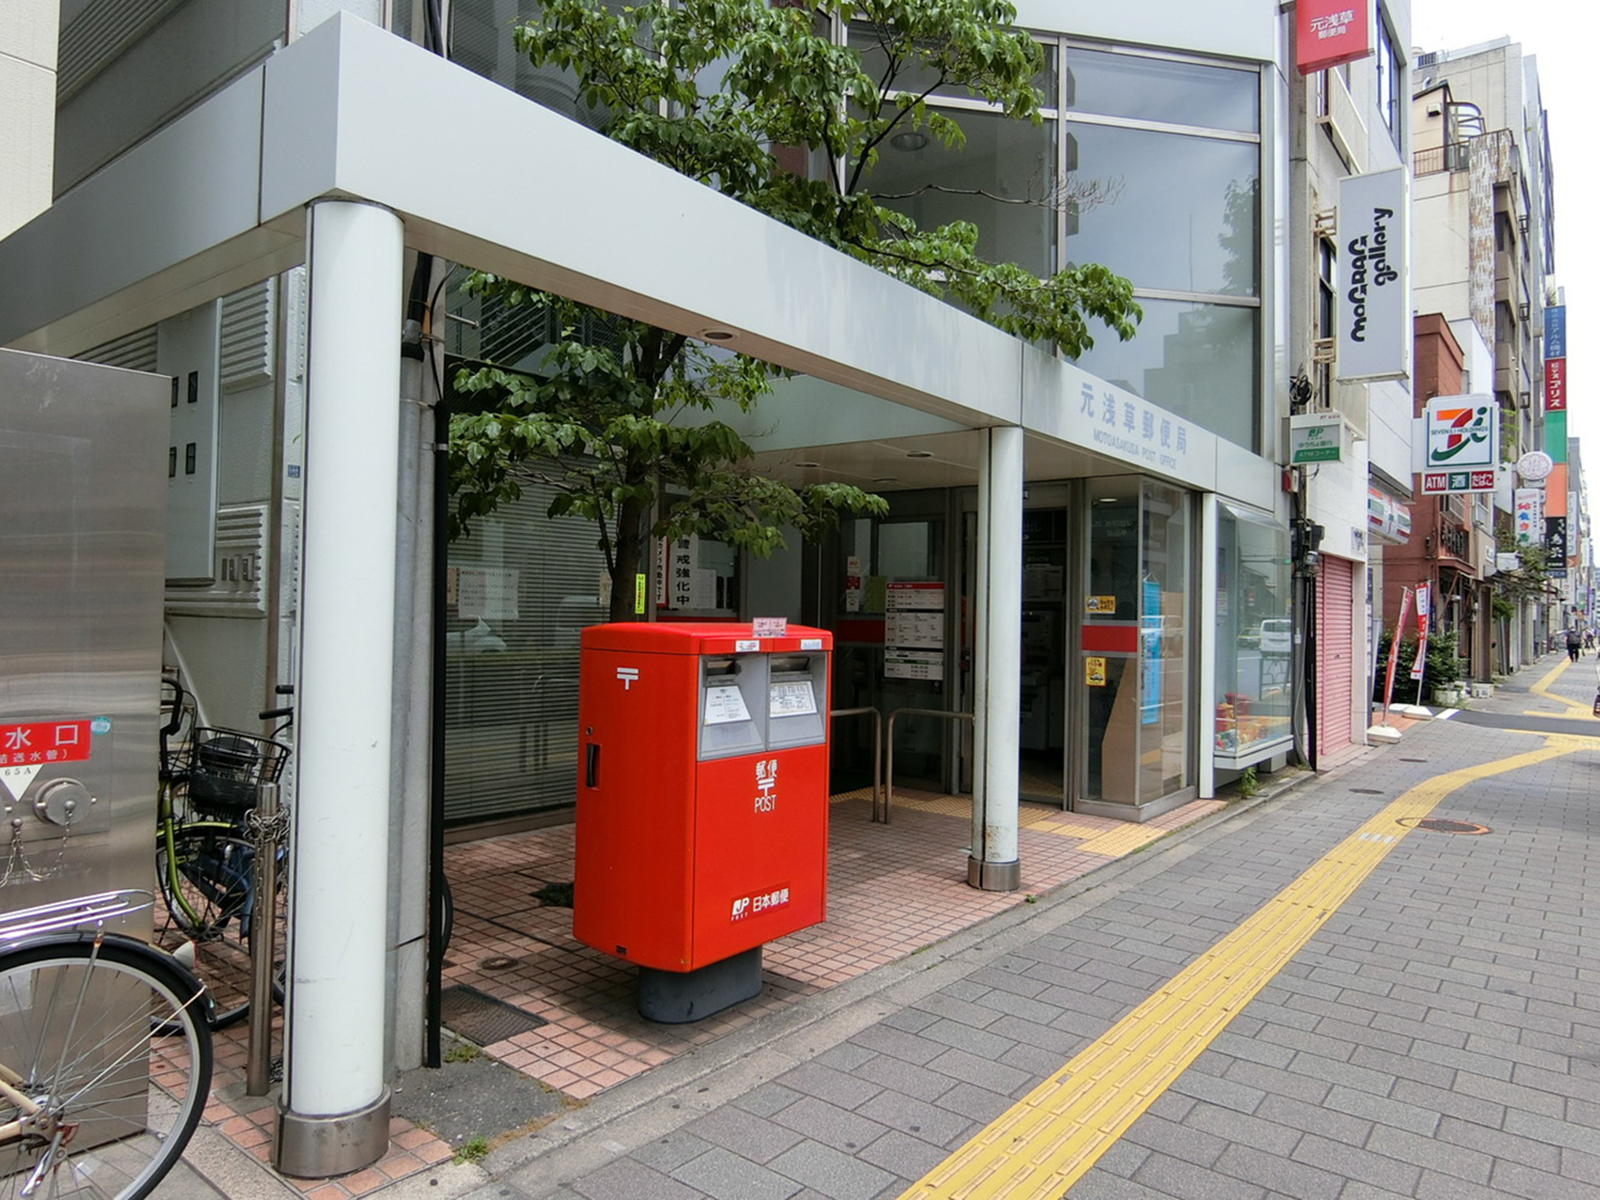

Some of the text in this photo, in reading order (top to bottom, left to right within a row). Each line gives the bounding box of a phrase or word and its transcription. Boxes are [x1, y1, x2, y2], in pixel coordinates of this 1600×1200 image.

[1309, 9, 1354, 32] 元浅草
[1317, 24, 1346, 40] 郵便局
[1368, 207, 1398, 287] gallery
[1080, 381, 1187, 456] 元浅草郵便局
[1093, 428, 1176, 470] MOTOASAKUSA POST OFFICE
[1425, 475, 1446, 489] ATM
[1451, 473, 1466, 488] 酒
[1472, 472, 1493, 487] たばこ
[676, 538, 691, 606] 警戒強化中
[755, 759, 778, 781] 郵便
[754, 794, 777, 813] POST
[752, 888, 789, 913] 日本郵便
